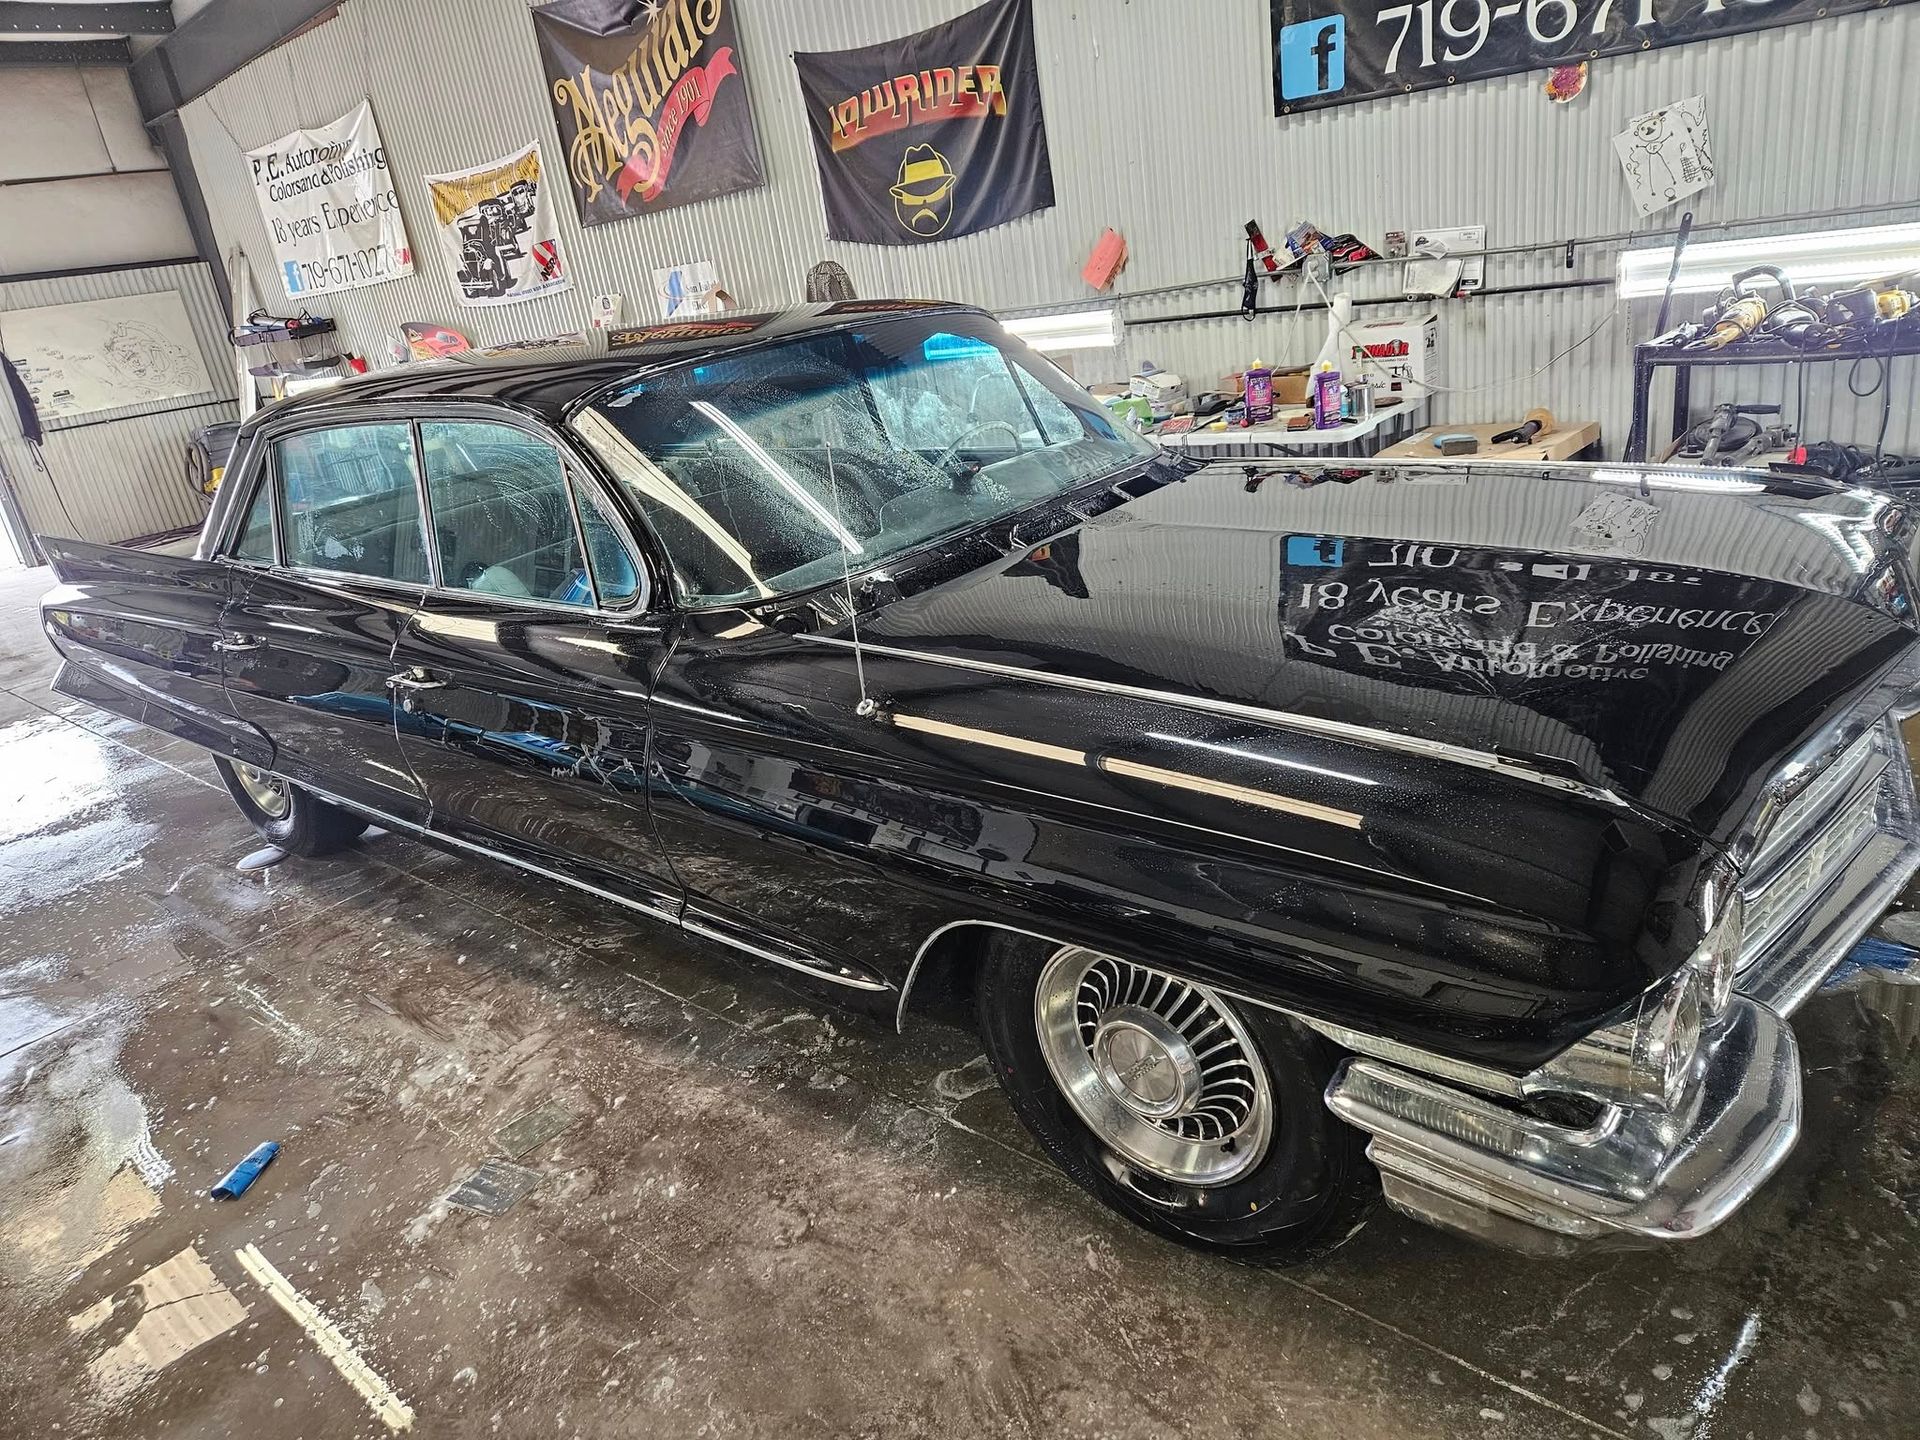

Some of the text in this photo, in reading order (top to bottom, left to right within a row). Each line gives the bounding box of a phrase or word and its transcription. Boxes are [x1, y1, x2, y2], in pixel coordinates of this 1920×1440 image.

[661, 77, 702, 157] since 1901
[828, 65, 1007, 148] LOWRIDER
[269, 171, 321, 203] Colorsand
[327, 146, 388, 183] Polishing
[271, 217, 288, 245] 18
[287, 214, 321, 248] years
